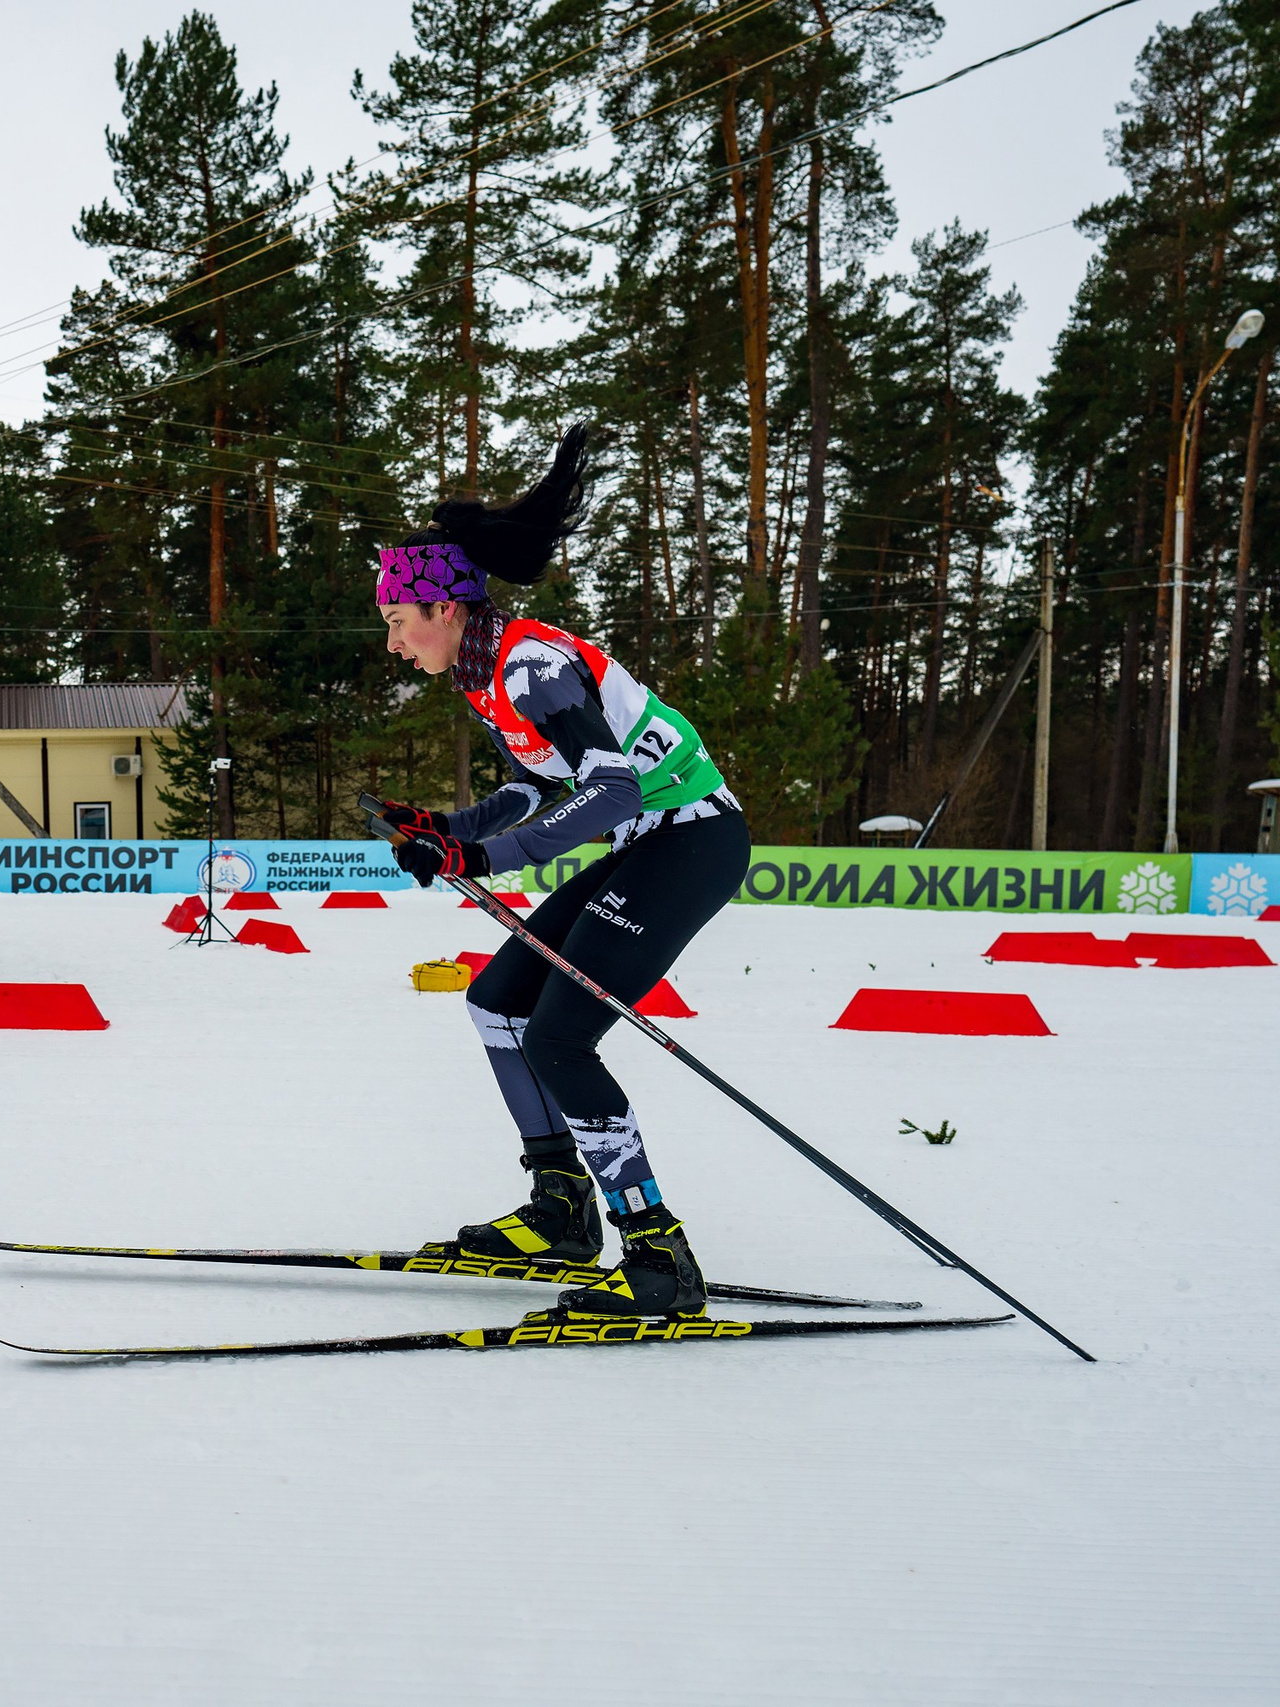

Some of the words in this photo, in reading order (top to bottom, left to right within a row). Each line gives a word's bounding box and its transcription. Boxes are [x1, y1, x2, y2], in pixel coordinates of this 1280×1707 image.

[633, 731, 673, 763] 12
[266, 852, 365, 864] ФЕДЕРАЦИЯ
[11, 872, 152, 893] РОССИИ
[266, 866, 345, 878] ЛЫЖНЫХ
[349, 866, 401, 878] ГОНОК
[266, 880, 331, 891] РОССИИ
[731, 861, 896, 905] ОРМА
[905, 865, 1106, 911] ЖИЗНИ
[585, 901, 644, 935] ORDSKI
[402, 1257, 606, 1284] FISCHE
[508, 1322, 753, 1345] FISCHER
